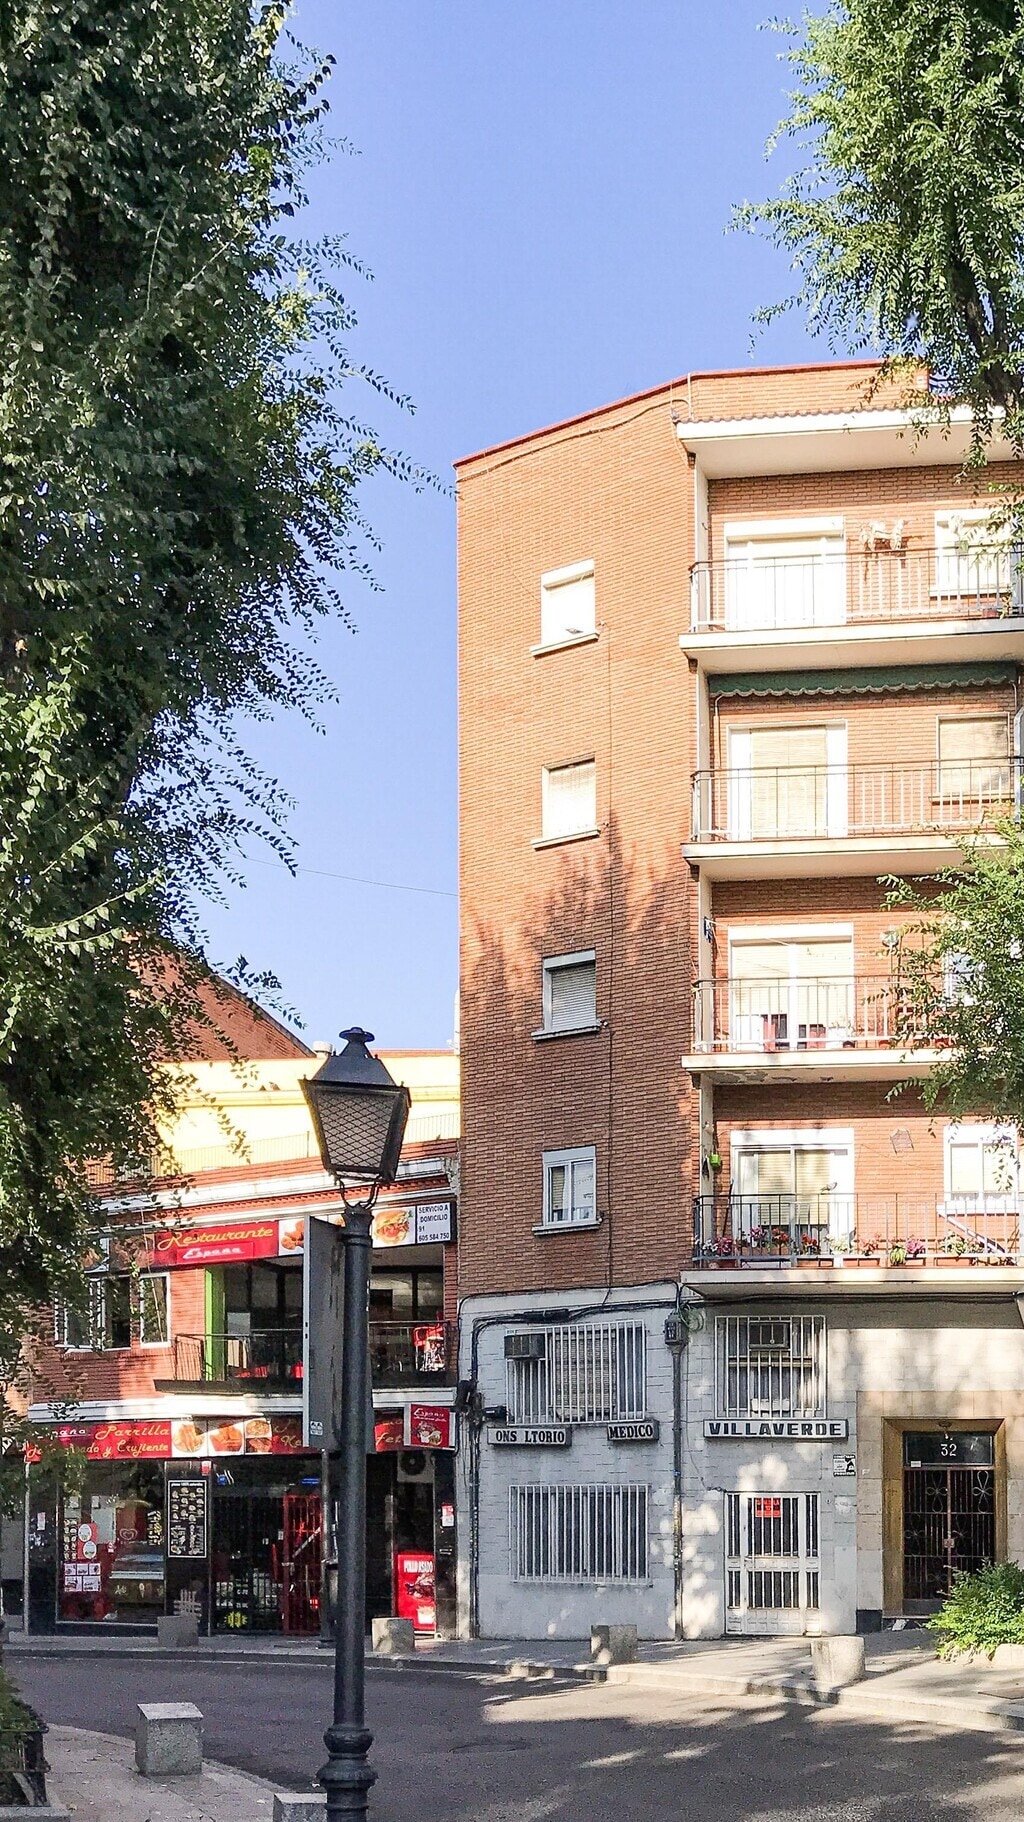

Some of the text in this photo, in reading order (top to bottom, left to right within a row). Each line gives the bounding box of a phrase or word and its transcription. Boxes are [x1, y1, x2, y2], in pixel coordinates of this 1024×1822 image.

[418, 1205, 443, 1213] SERVICIO
[420, 1214, 448, 1222] DOMICILIO
[157, 1227, 274, 1251] Restaurante
[95, 1425, 169, 1440] Parrilla
[608, 1424, 653, 1439] MEDICO
[709, 1422, 842, 1436] VILLAVERDE
[102, 1446, 112, 1457] y
[117, 1440, 169, 1456] Crujiente
[940, 1443, 957, 1457] 32
